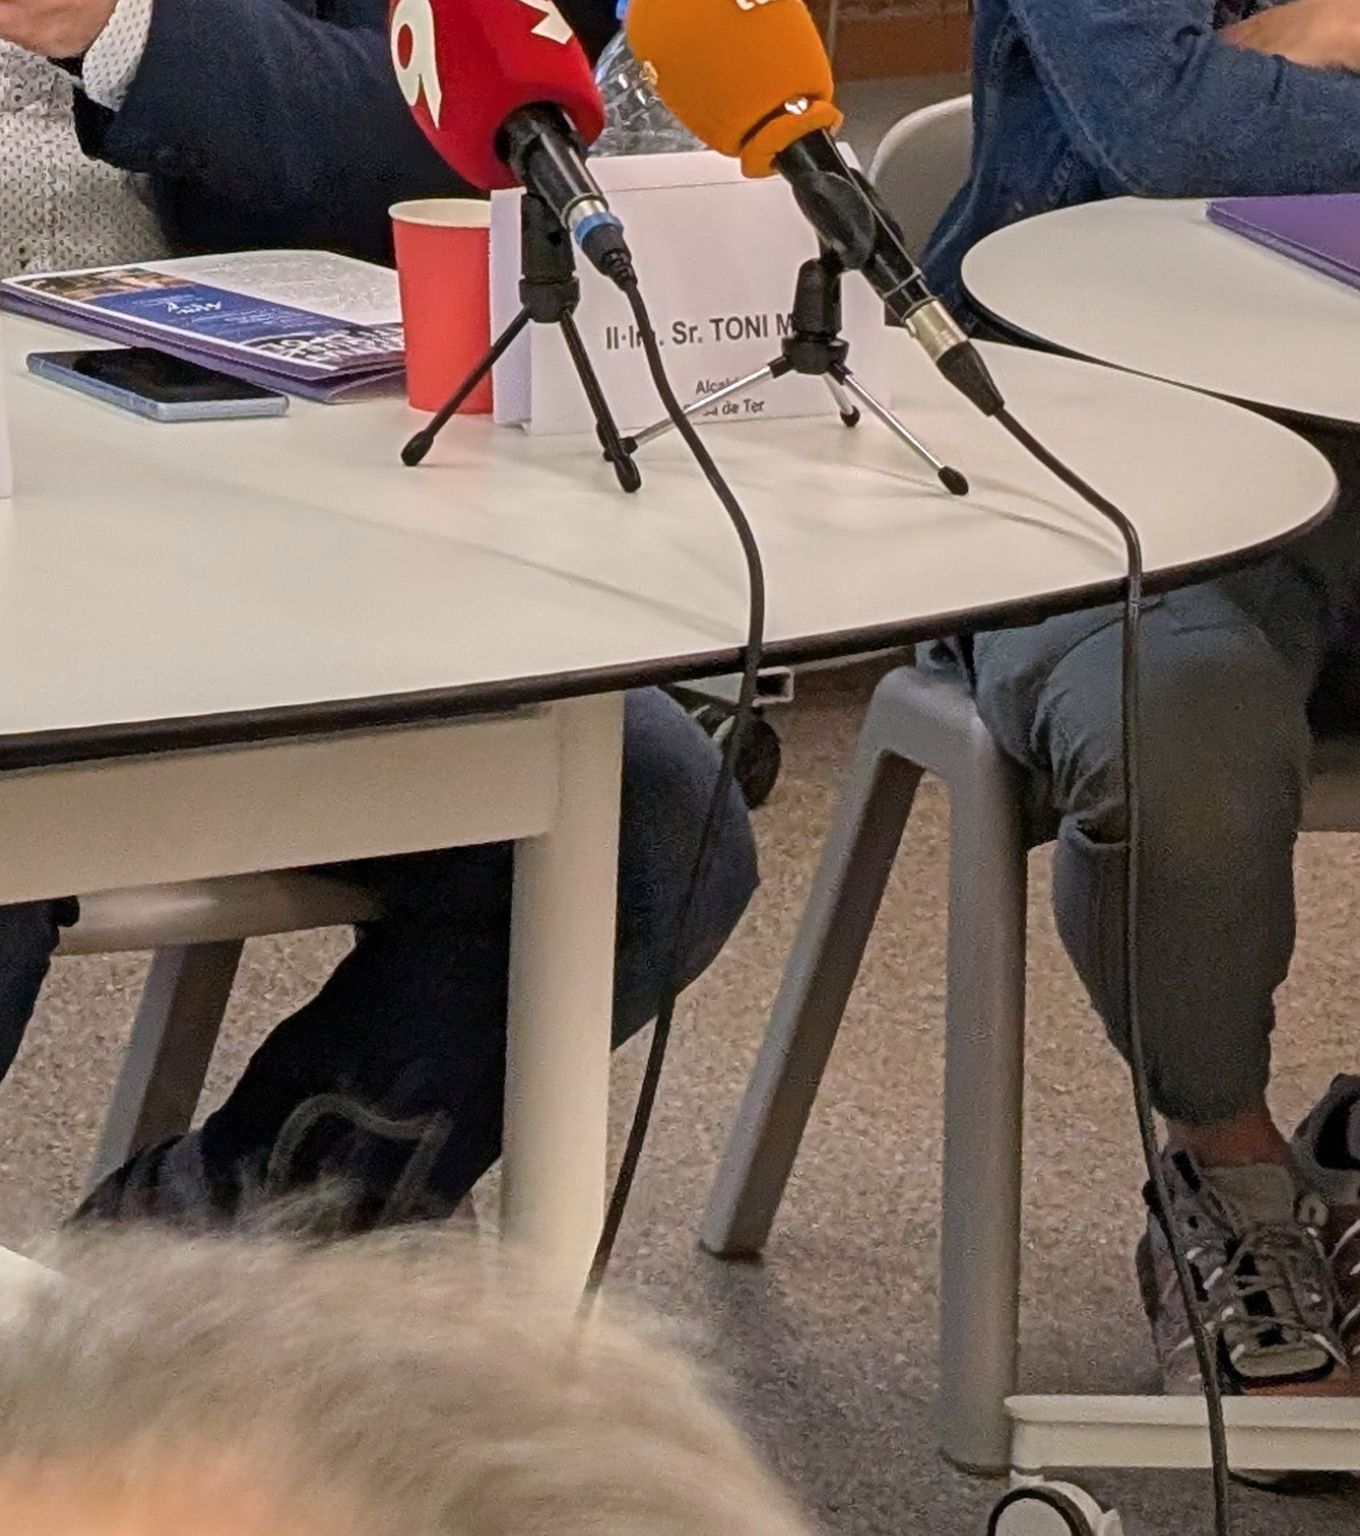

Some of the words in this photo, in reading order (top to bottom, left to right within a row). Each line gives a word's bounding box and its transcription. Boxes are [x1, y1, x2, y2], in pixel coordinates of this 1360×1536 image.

[672, 321, 704, 345] Sr.
[709, 314, 768, 342] TONI
[743, 398, 766, 414] Ter
